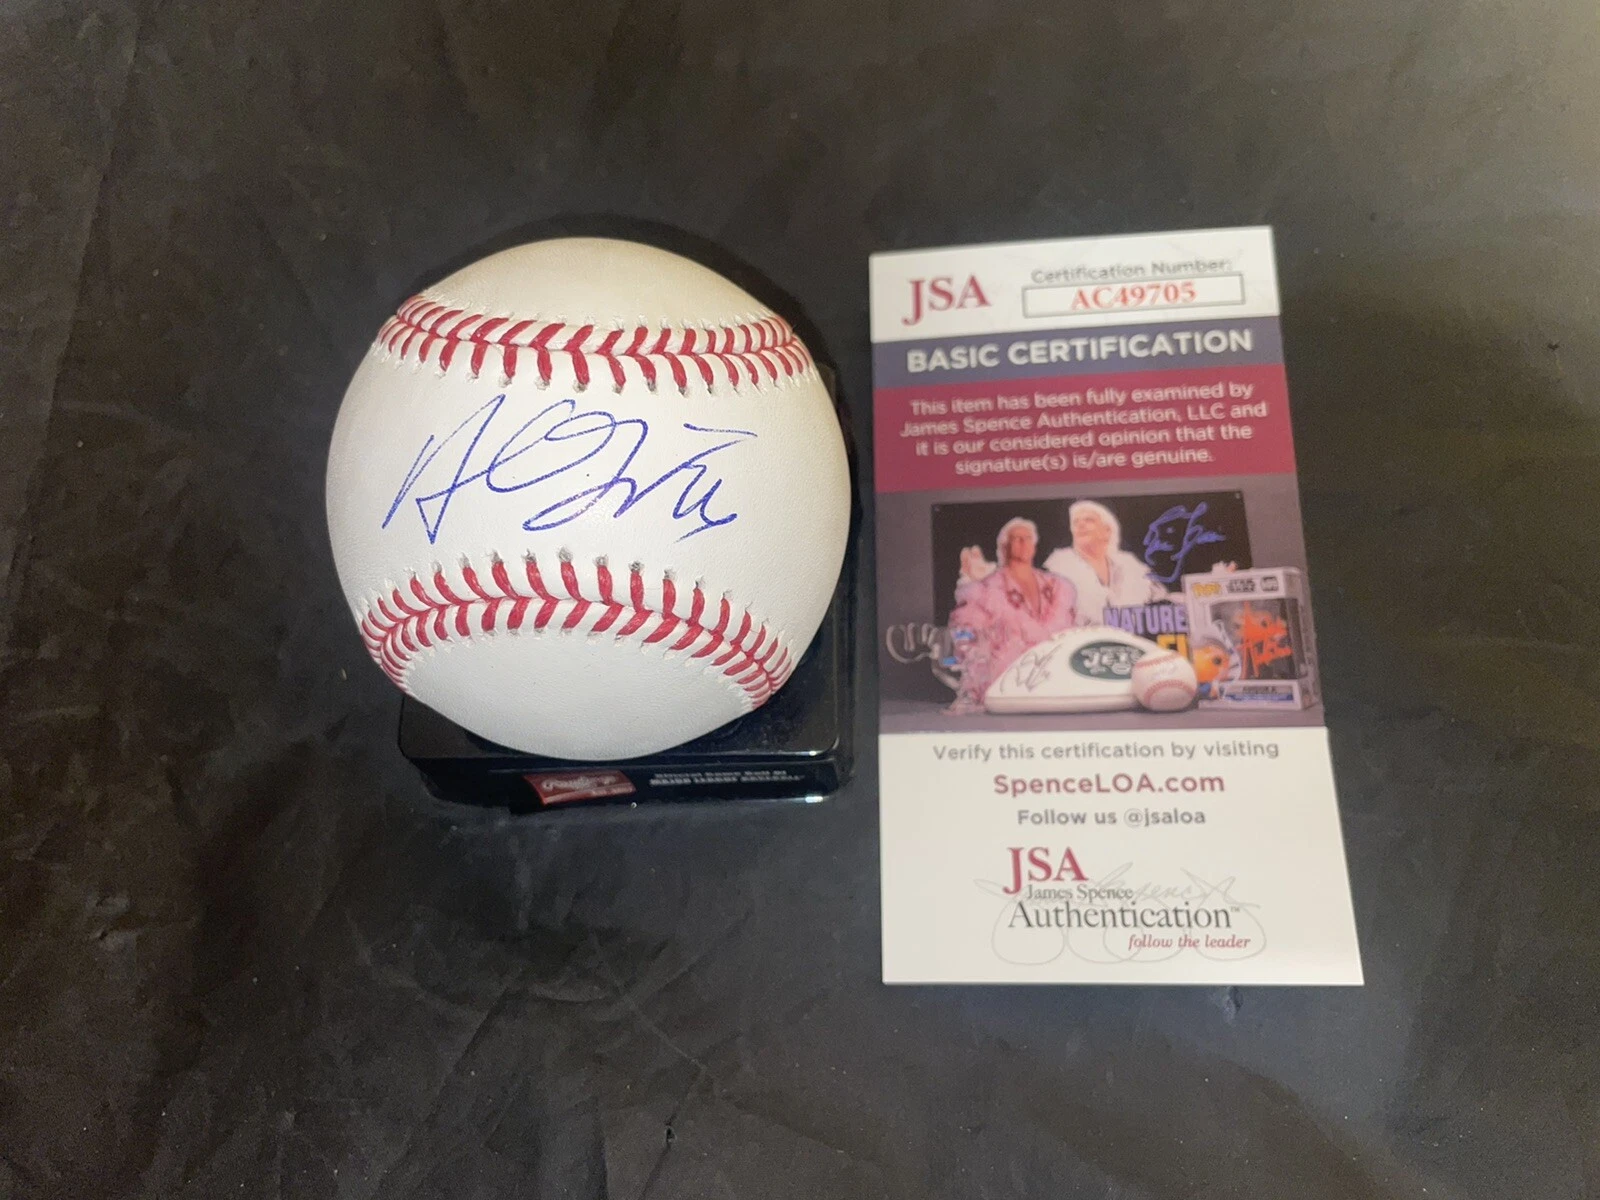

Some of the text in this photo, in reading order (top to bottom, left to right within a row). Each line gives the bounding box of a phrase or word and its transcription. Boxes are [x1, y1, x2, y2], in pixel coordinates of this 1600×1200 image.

[1030, 257, 1234, 285] Certification Number:
[902, 273, 990, 326] JSA
[1071, 281, 1196, 311] AC49705
[906, 329, 1253, 374] BASIC CERTIFICATION
[910, 381, 1255, 416] This item has been fully examined by
[900, 400, 1269, 437] James Spence Authentication, LLC and
[915, 422, 1254, 456] it is our considered opinion that the
[955, 447, 1215, 477] signature(s) is/are genuine.
[1103, 604, 1189, 635] NATURE
[933, 740, 1280, 762] Verify this certification by visiting
[993, 773, 1226, 798] SpenceLOA.com
[1017, 808, 1207, 828] Follow us @jsaloa
[1002, 846, 1090, 896] JSA
[1026, 883, 1135, 903] James Spence
[1128, 934, 1252, 951] follow the leader
